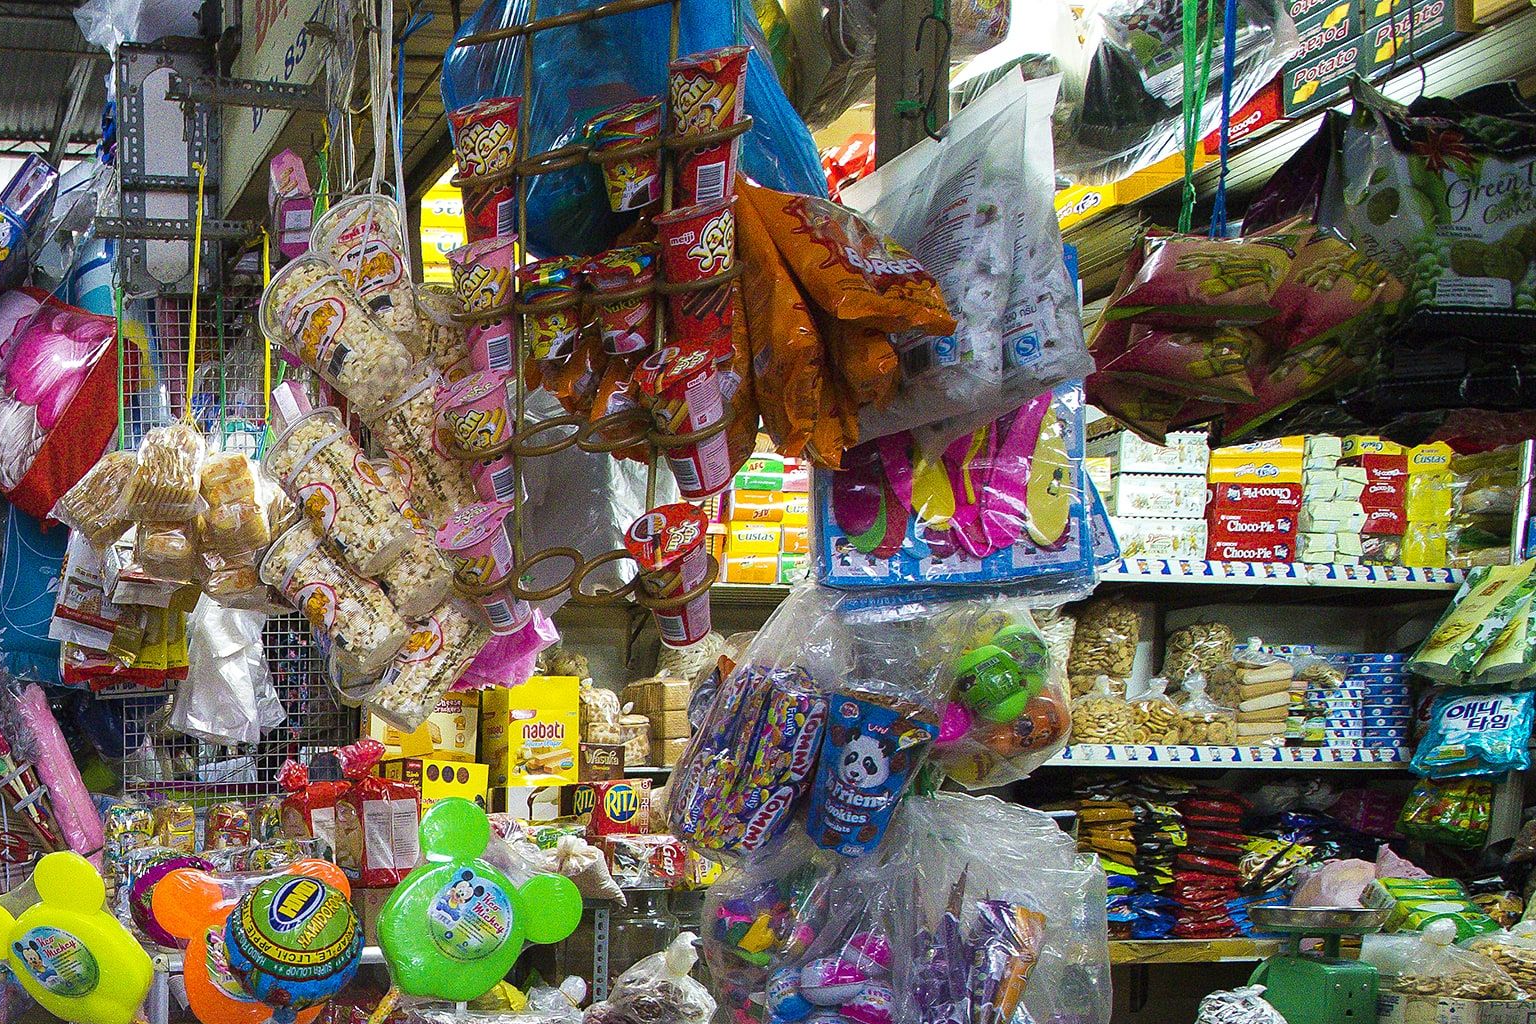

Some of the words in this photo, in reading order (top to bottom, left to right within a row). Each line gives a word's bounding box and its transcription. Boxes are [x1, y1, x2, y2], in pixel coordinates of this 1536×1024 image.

[1292, 46, 1359, 89] Potato
[669, 231, 695, 247] meiji
[1413, 453, 1446, 464] Custas
[737, 533, 774, 541] Custas
[784, 706, 797, 737] Fruity
[1446, 700, 1502, 719] 애니
[522, 721, 565, 739] nabati
[1468, 714, 1510, 731] 타임
[792, 710, 826, 778] TOMMY
[574, 789, 596, 814] RITZ
[605, 786, 639, 815] RITZ
[742, 792, 793, 851] TOMMY
[277, 879, 318, 919] HMD
[472, 902, 505, 935] Mickey
[43, 940, 78, 959] Mickey
